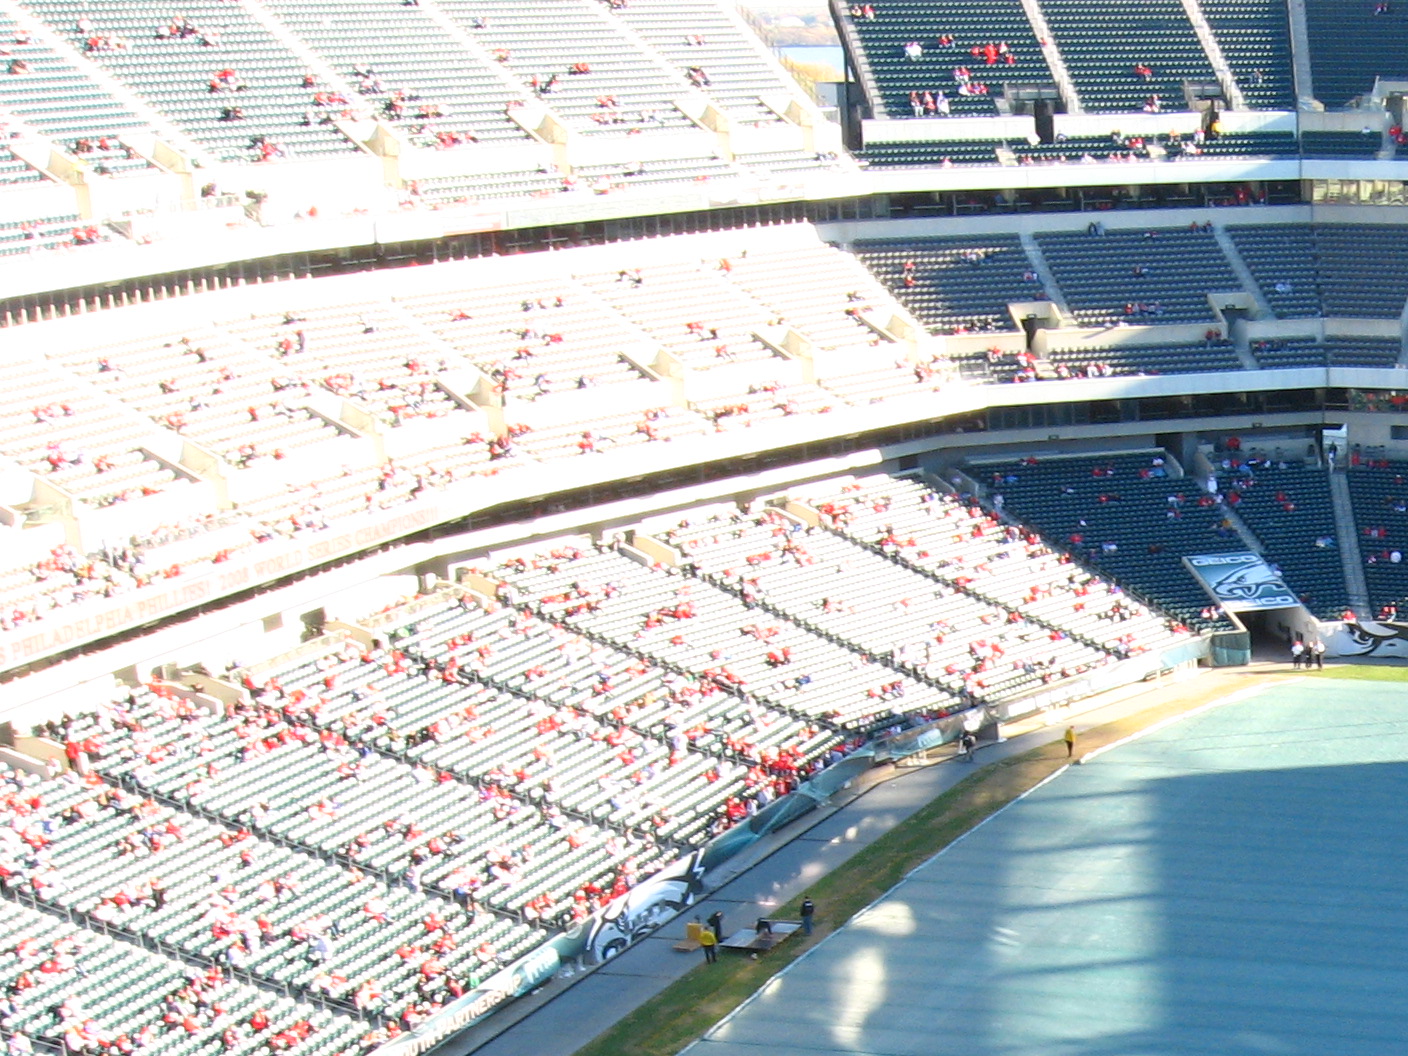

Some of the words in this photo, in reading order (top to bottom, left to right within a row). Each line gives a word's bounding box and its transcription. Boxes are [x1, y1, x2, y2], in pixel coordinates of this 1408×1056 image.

[1192, 555, 1260, 567] GEICO
[11, 605, 134, 661] PHILADELPHIA
[253, 550, 303, 577] WORLD
[307, 534, 353, 562] SERIES
